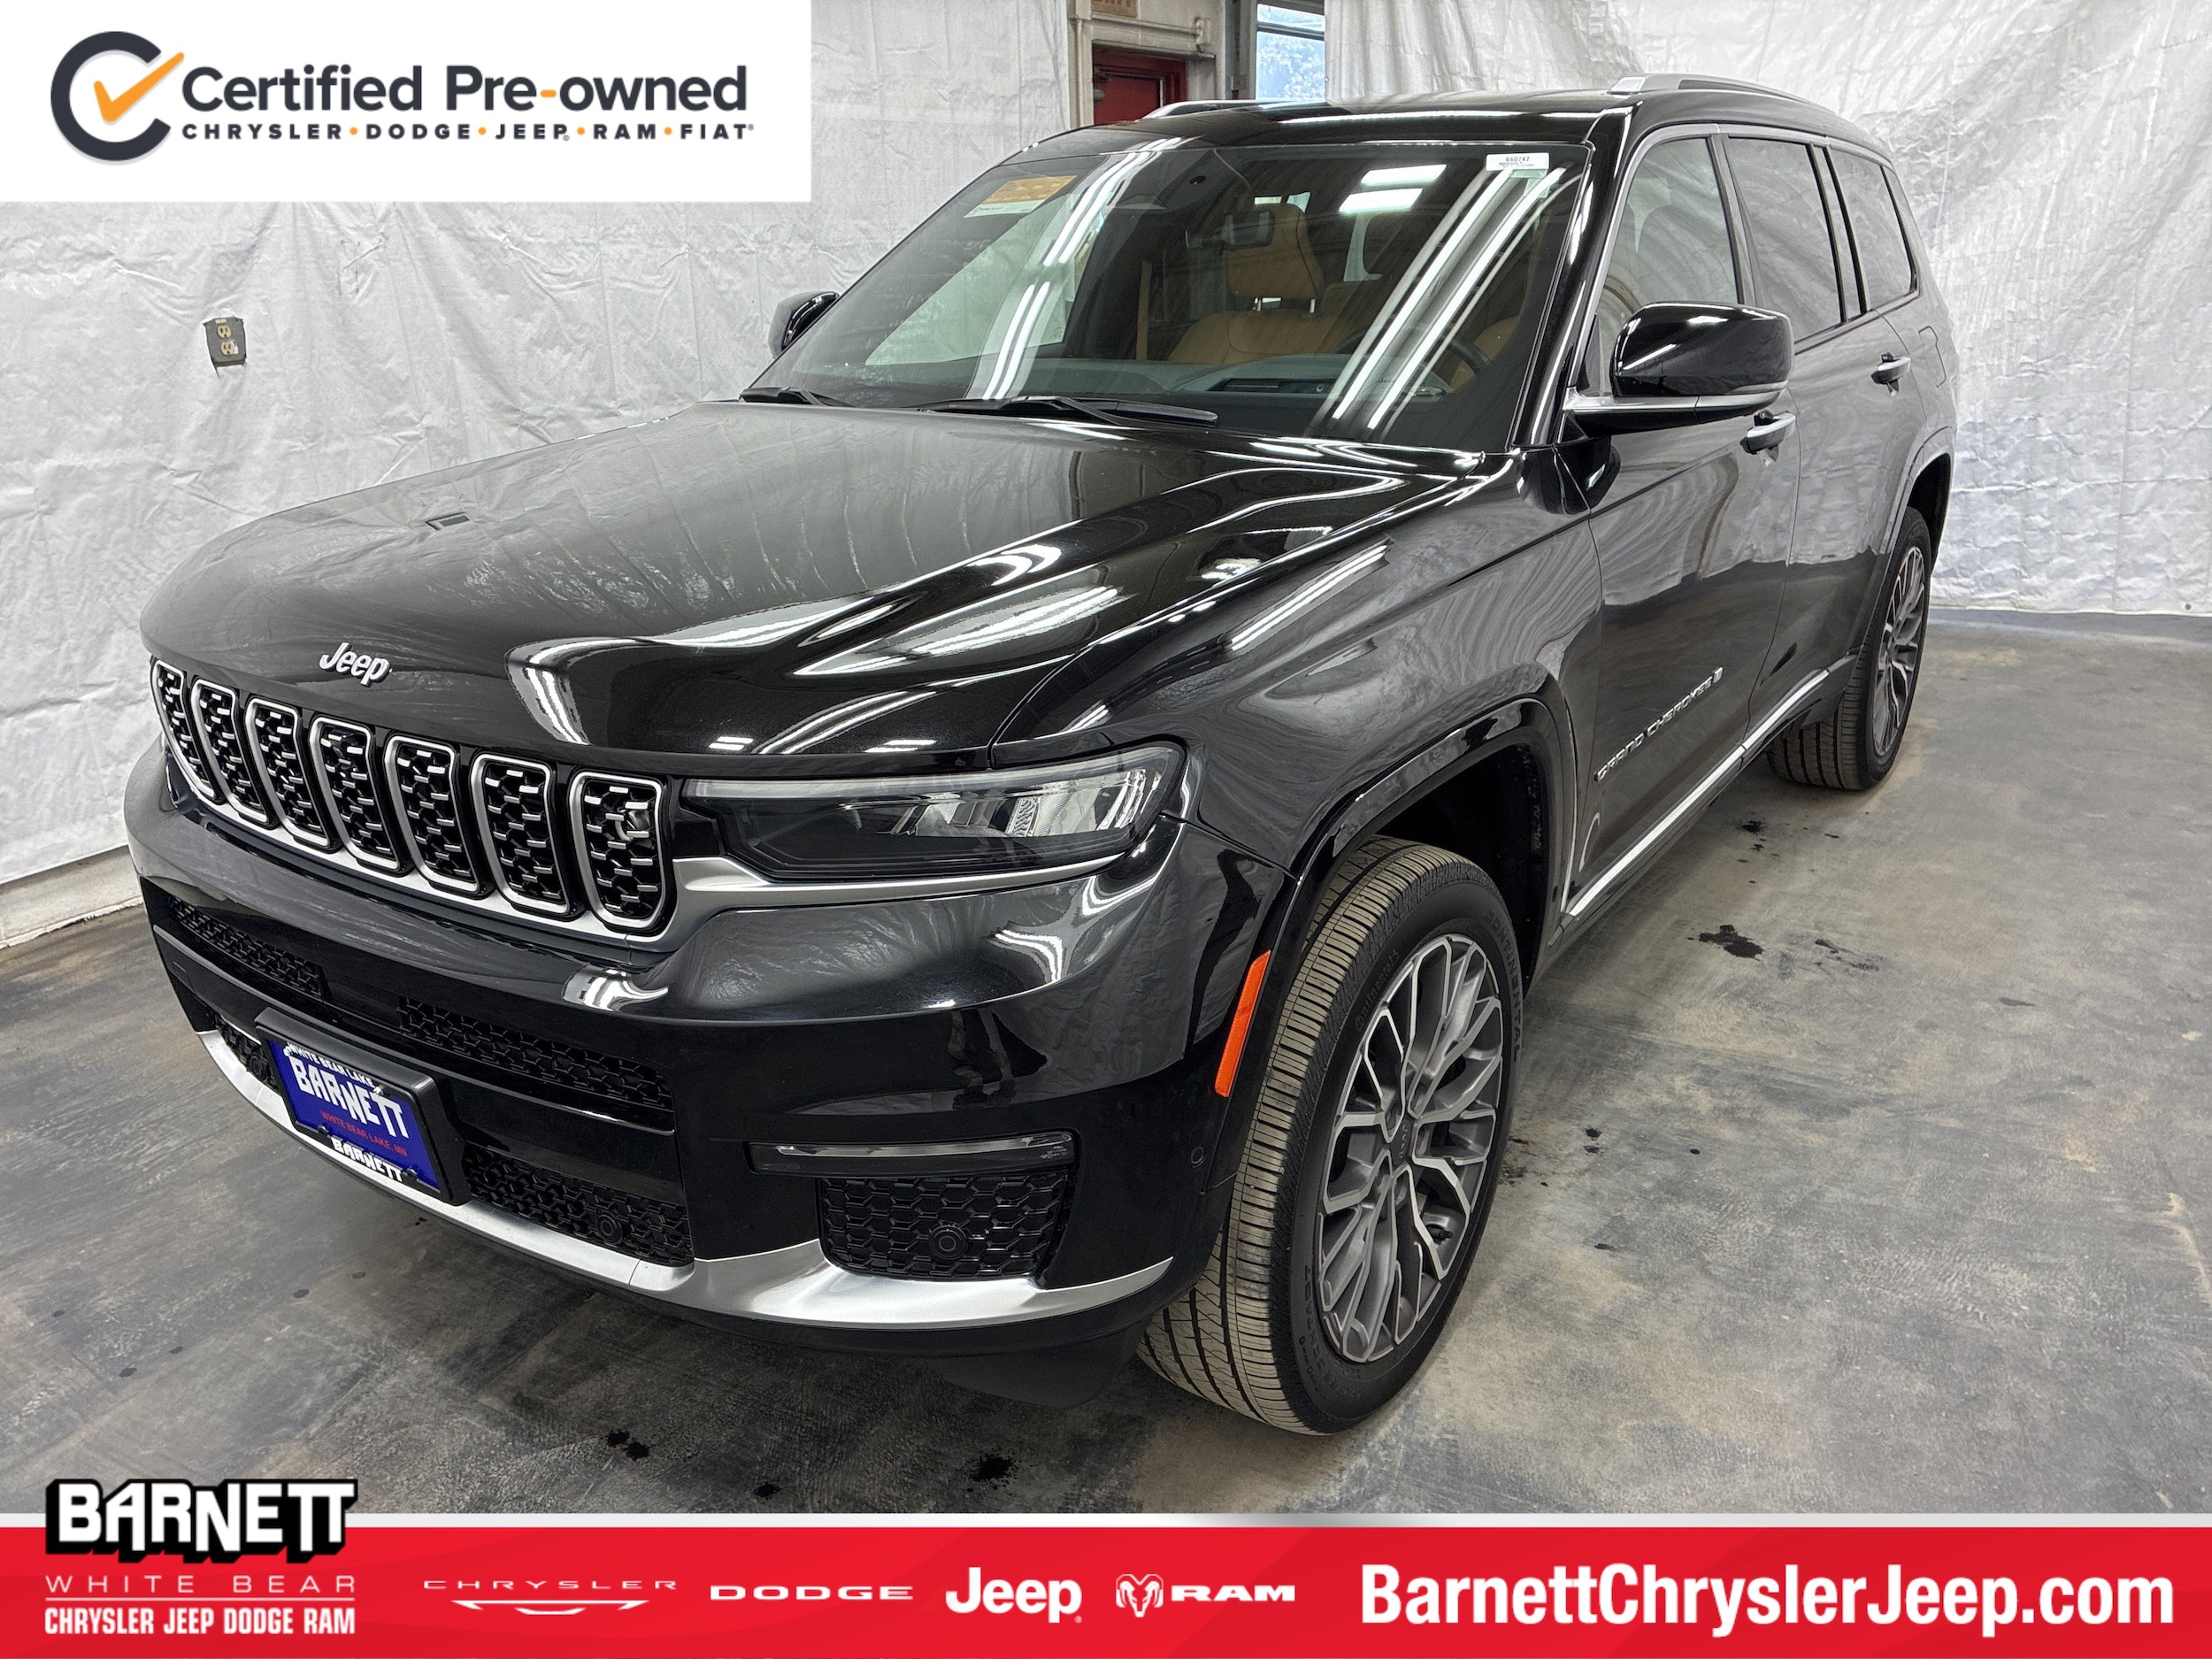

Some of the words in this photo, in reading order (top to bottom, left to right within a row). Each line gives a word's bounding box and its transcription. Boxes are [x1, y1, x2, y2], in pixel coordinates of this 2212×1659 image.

[319, 641, 390, 687] Jeep
[1595, 732, 1645, 783] GRAND
[1645, 676, 1714, 738] CHEROKEE
[287, 1041, 320, 1064] WHITE
[319, 1056, 348, 1077] BEAR
[346, 1068, 376, 1088] LAKE
[288, 1056, 410, 1139] BARNETT
[331, 1136, 403, 1183] BARNETT
